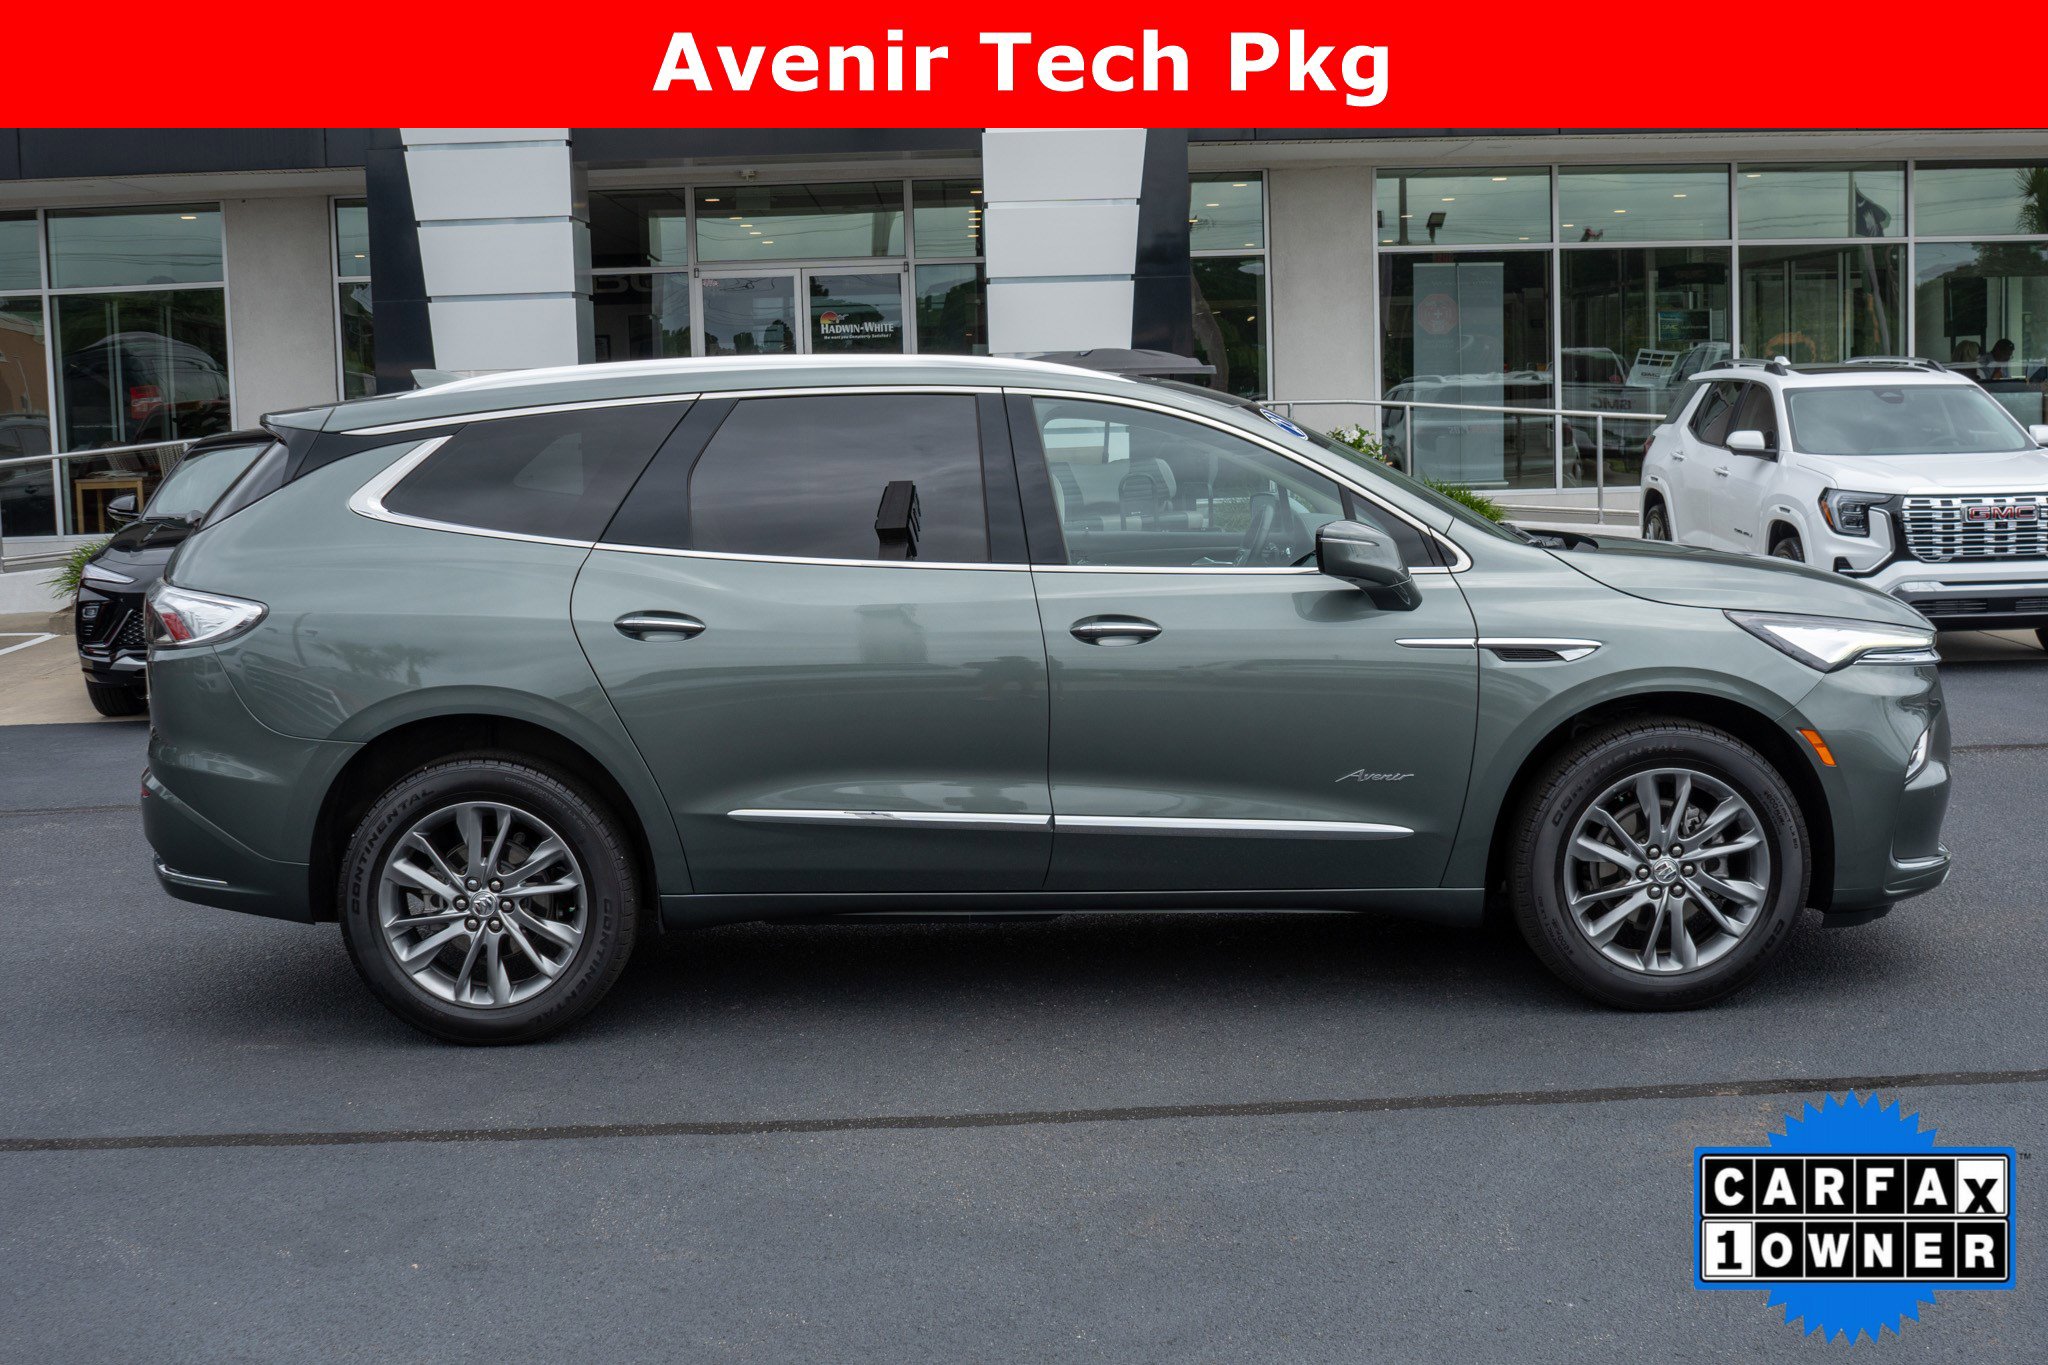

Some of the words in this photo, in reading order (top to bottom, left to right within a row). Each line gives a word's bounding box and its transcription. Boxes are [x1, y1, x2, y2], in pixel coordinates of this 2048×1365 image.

[821, 322, 894, 334] HADWIN-WHITE
[1968, 505, 2036, 520] GMC
[1334, 769, 1414, 783] Avenir
[352, 789, 435, 915] CONTINENTAL
